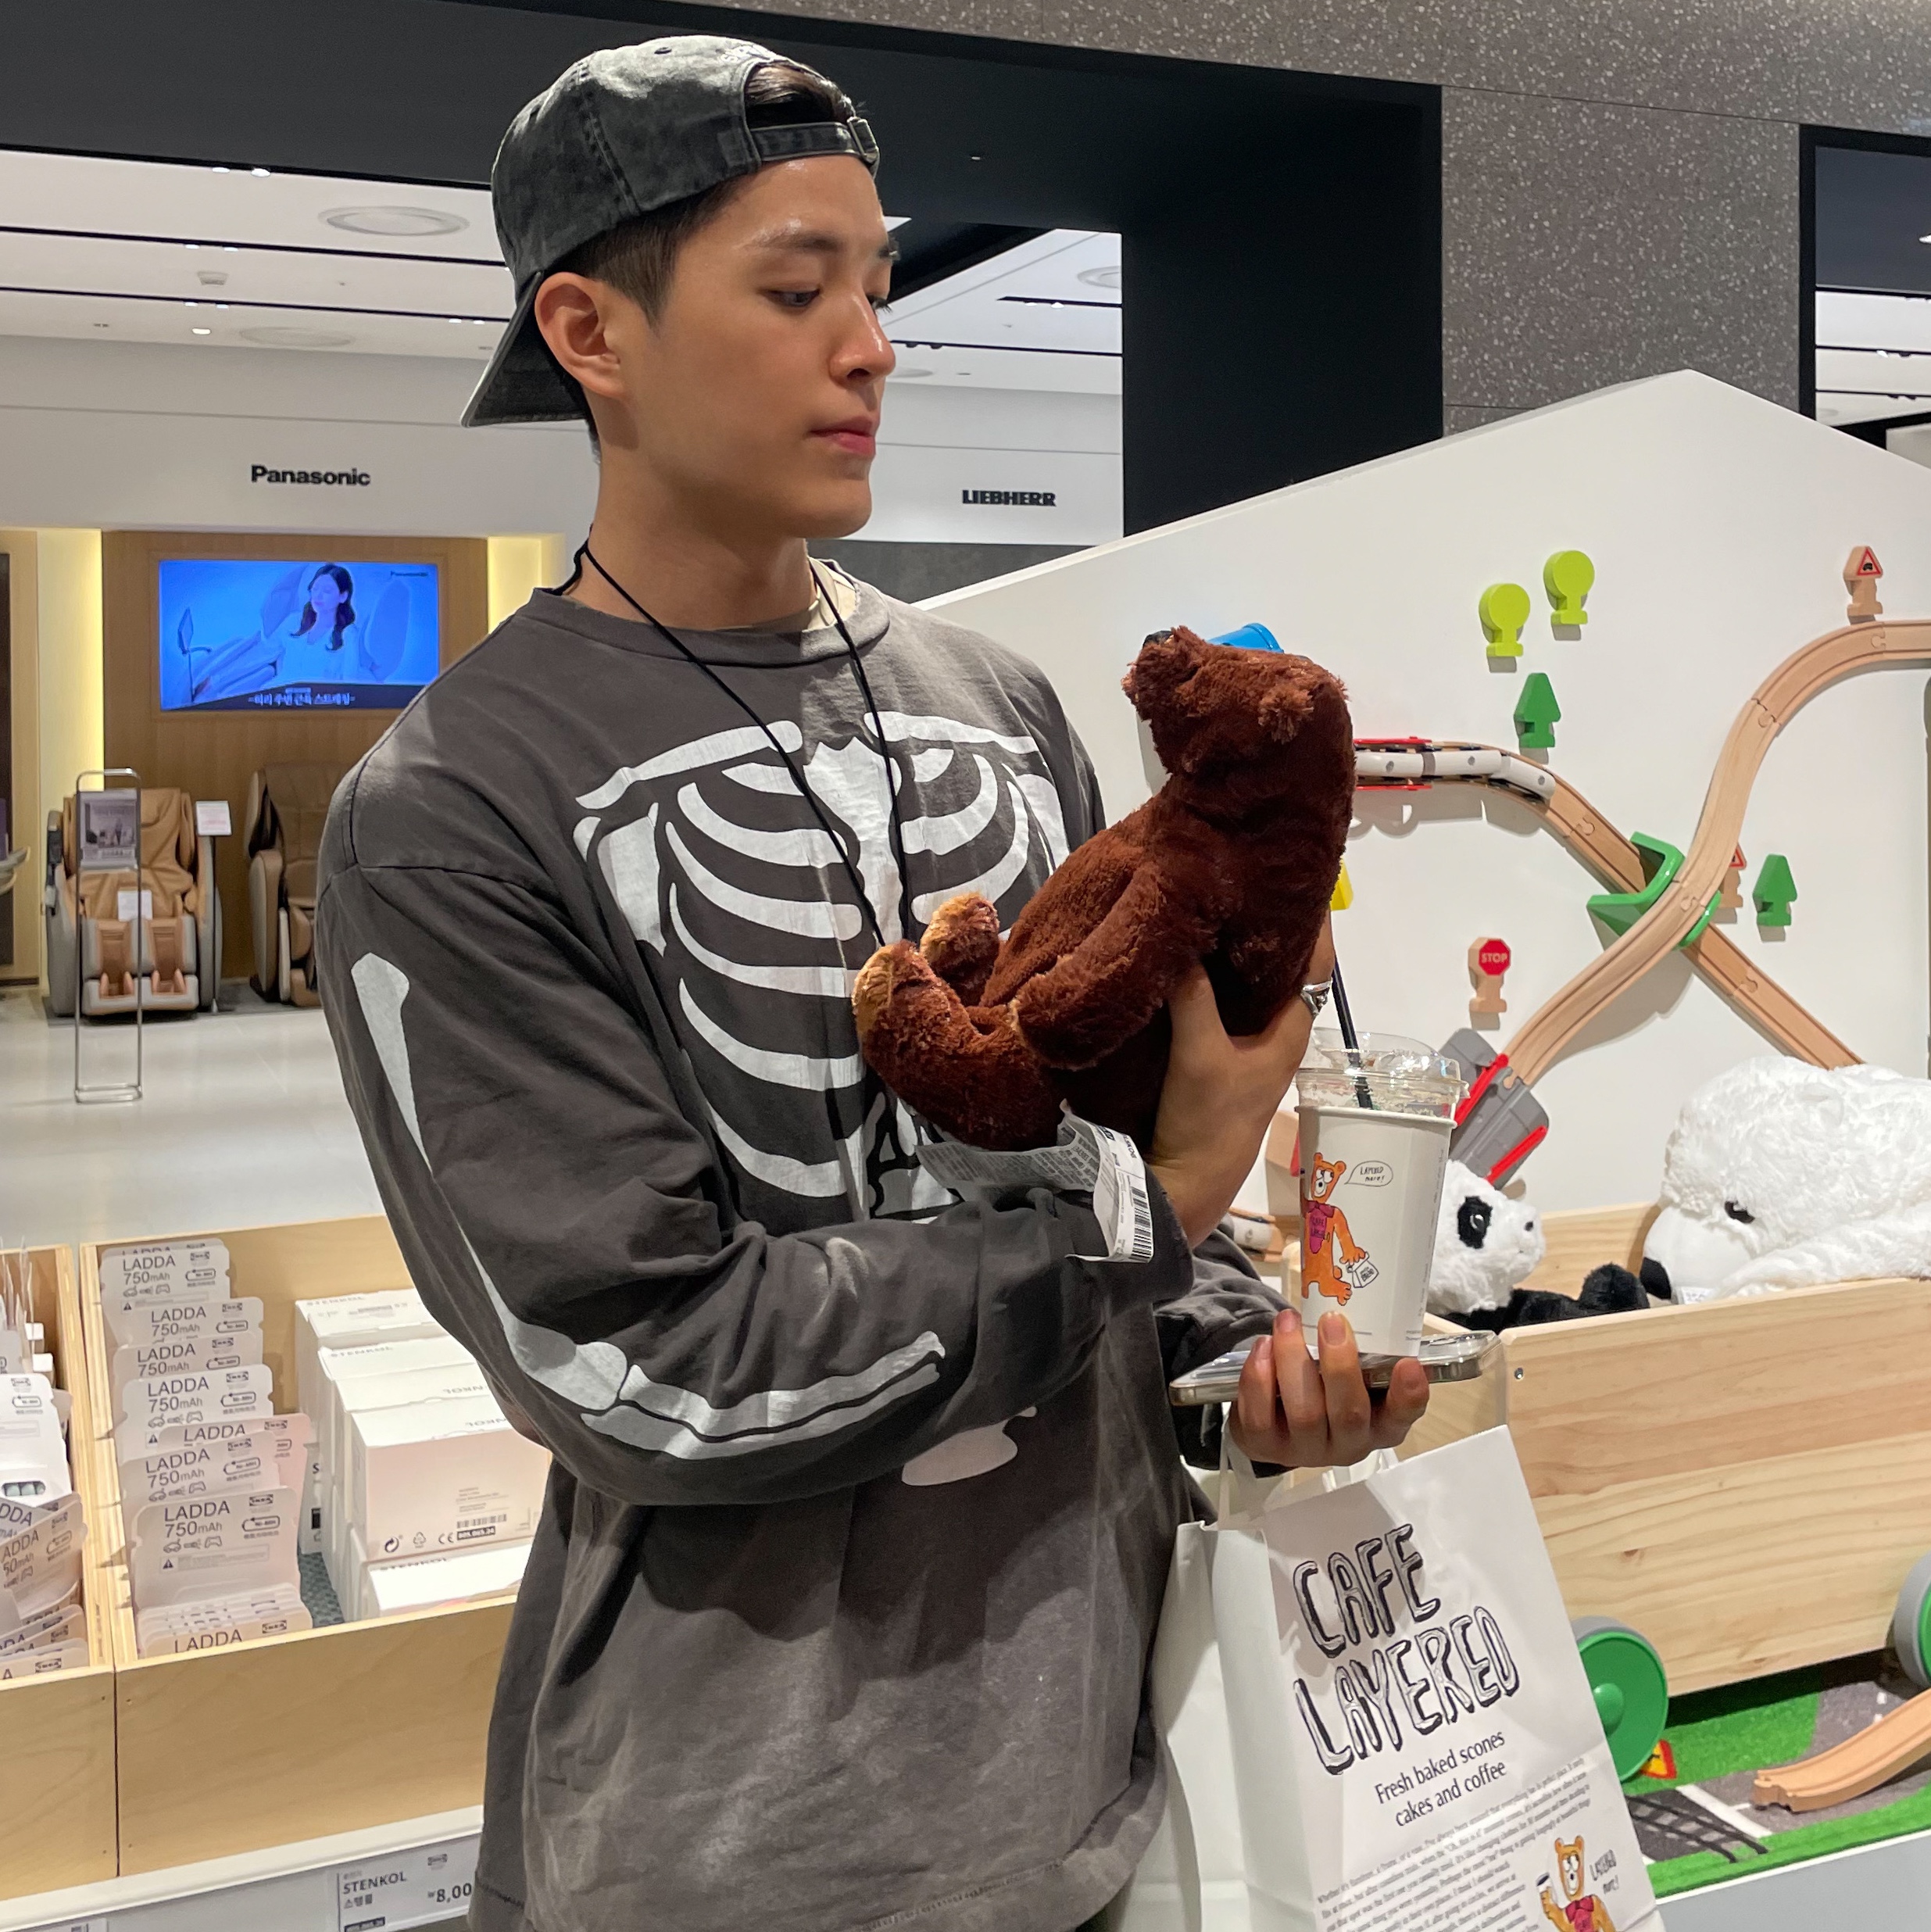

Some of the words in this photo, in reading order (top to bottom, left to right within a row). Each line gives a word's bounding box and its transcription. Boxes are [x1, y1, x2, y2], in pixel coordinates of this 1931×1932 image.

[251, 464, 371, 486] Panasonic
[962, 489, 1057, 506] LIEBHERR
[1481, 953, 1508, 963] STOP
[123, 1254, 176, 1272] LADDA
[123, 1271, 170, 1286] 750mAh
[152, 1306, 206, 1323] LADDA
[152, 1322, 200, 1337] 750mAh
[138, 1343, 196, 1363] LADDA
[138, 1361, 190, 1377] 750mAh
[148, 1376, 209, 1397] LADDA
[148, 1396, 203, 1413] 750mAh
[184, 1424, 246, 1442] LADDA
[145, 1447, 210, 1474] LADDA
[147, 1468, 205, 1488] 750mAh
[0, 1503, 32, 1526] DDA
[164, 1500, 231, 1522] LADDA
[165, 1521, 223, 1538] 750mAh
[2, 1530, 39, 1559] ADDA
[3, 1552, 34, 1576] 50mAh
[1293, 1522, 1440, 1659] CAFE
[1292, 1605, 1520, 1776] LAYERED
[1375, 1772, 1414, 1804] Fresh
[1412, 1749, 1457, 1784] baked
[1460, 1732, 1505, 1764] scones
[1396, 1801, 1433, 1826] cakes
[1435, 1777, 1461, 1807] and
[1464, 1762, 1507, 1792] coffee
[343, 1871, 407, 1894] STENKOL
